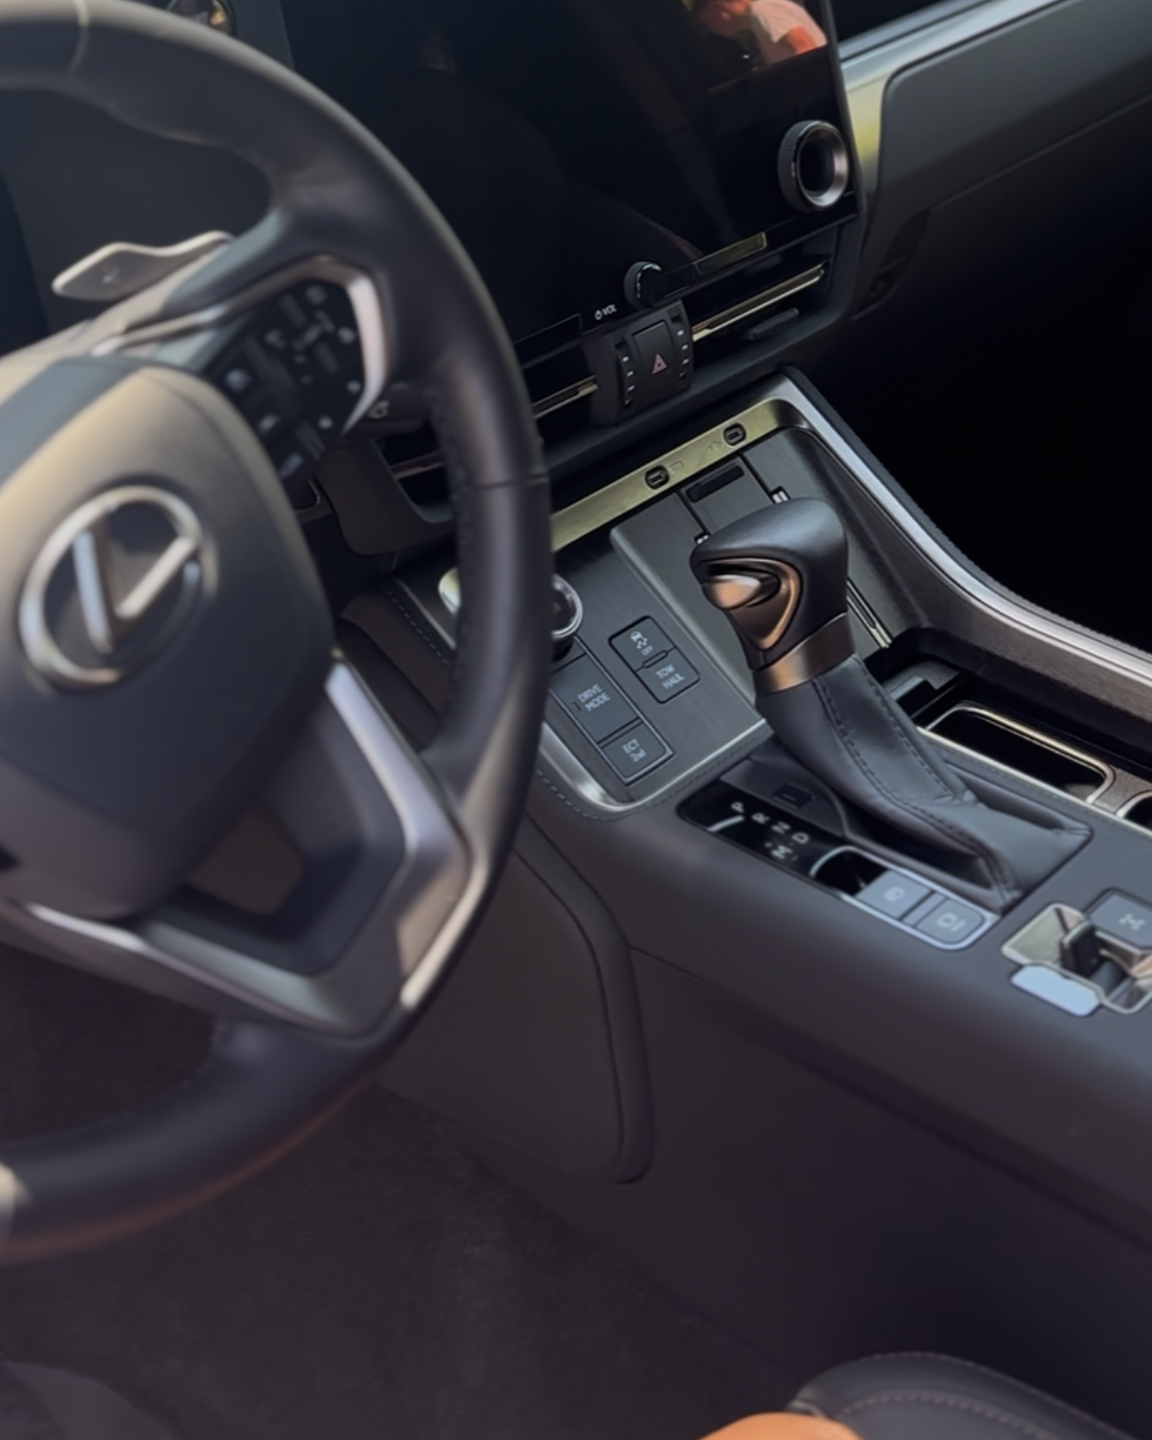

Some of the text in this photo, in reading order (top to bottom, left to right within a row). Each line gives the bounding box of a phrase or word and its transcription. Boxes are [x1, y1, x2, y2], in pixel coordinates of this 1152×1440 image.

[602, 304, 617, 316] VOL
[656, 664, 675, 678] TOW
[662, 673, 685, 689] HAUL
[578, 684, 603, 702] DRIVE
[585, 692, 610, 711] MODE
[623, 739, 639, 753] ECT
[731, 801, 744, 813] P
[751, 812, 770, 825] R
[771, 821, 791, 835] N
[792, 832, 809, 844] D
[771, 845, 792, 859] M
